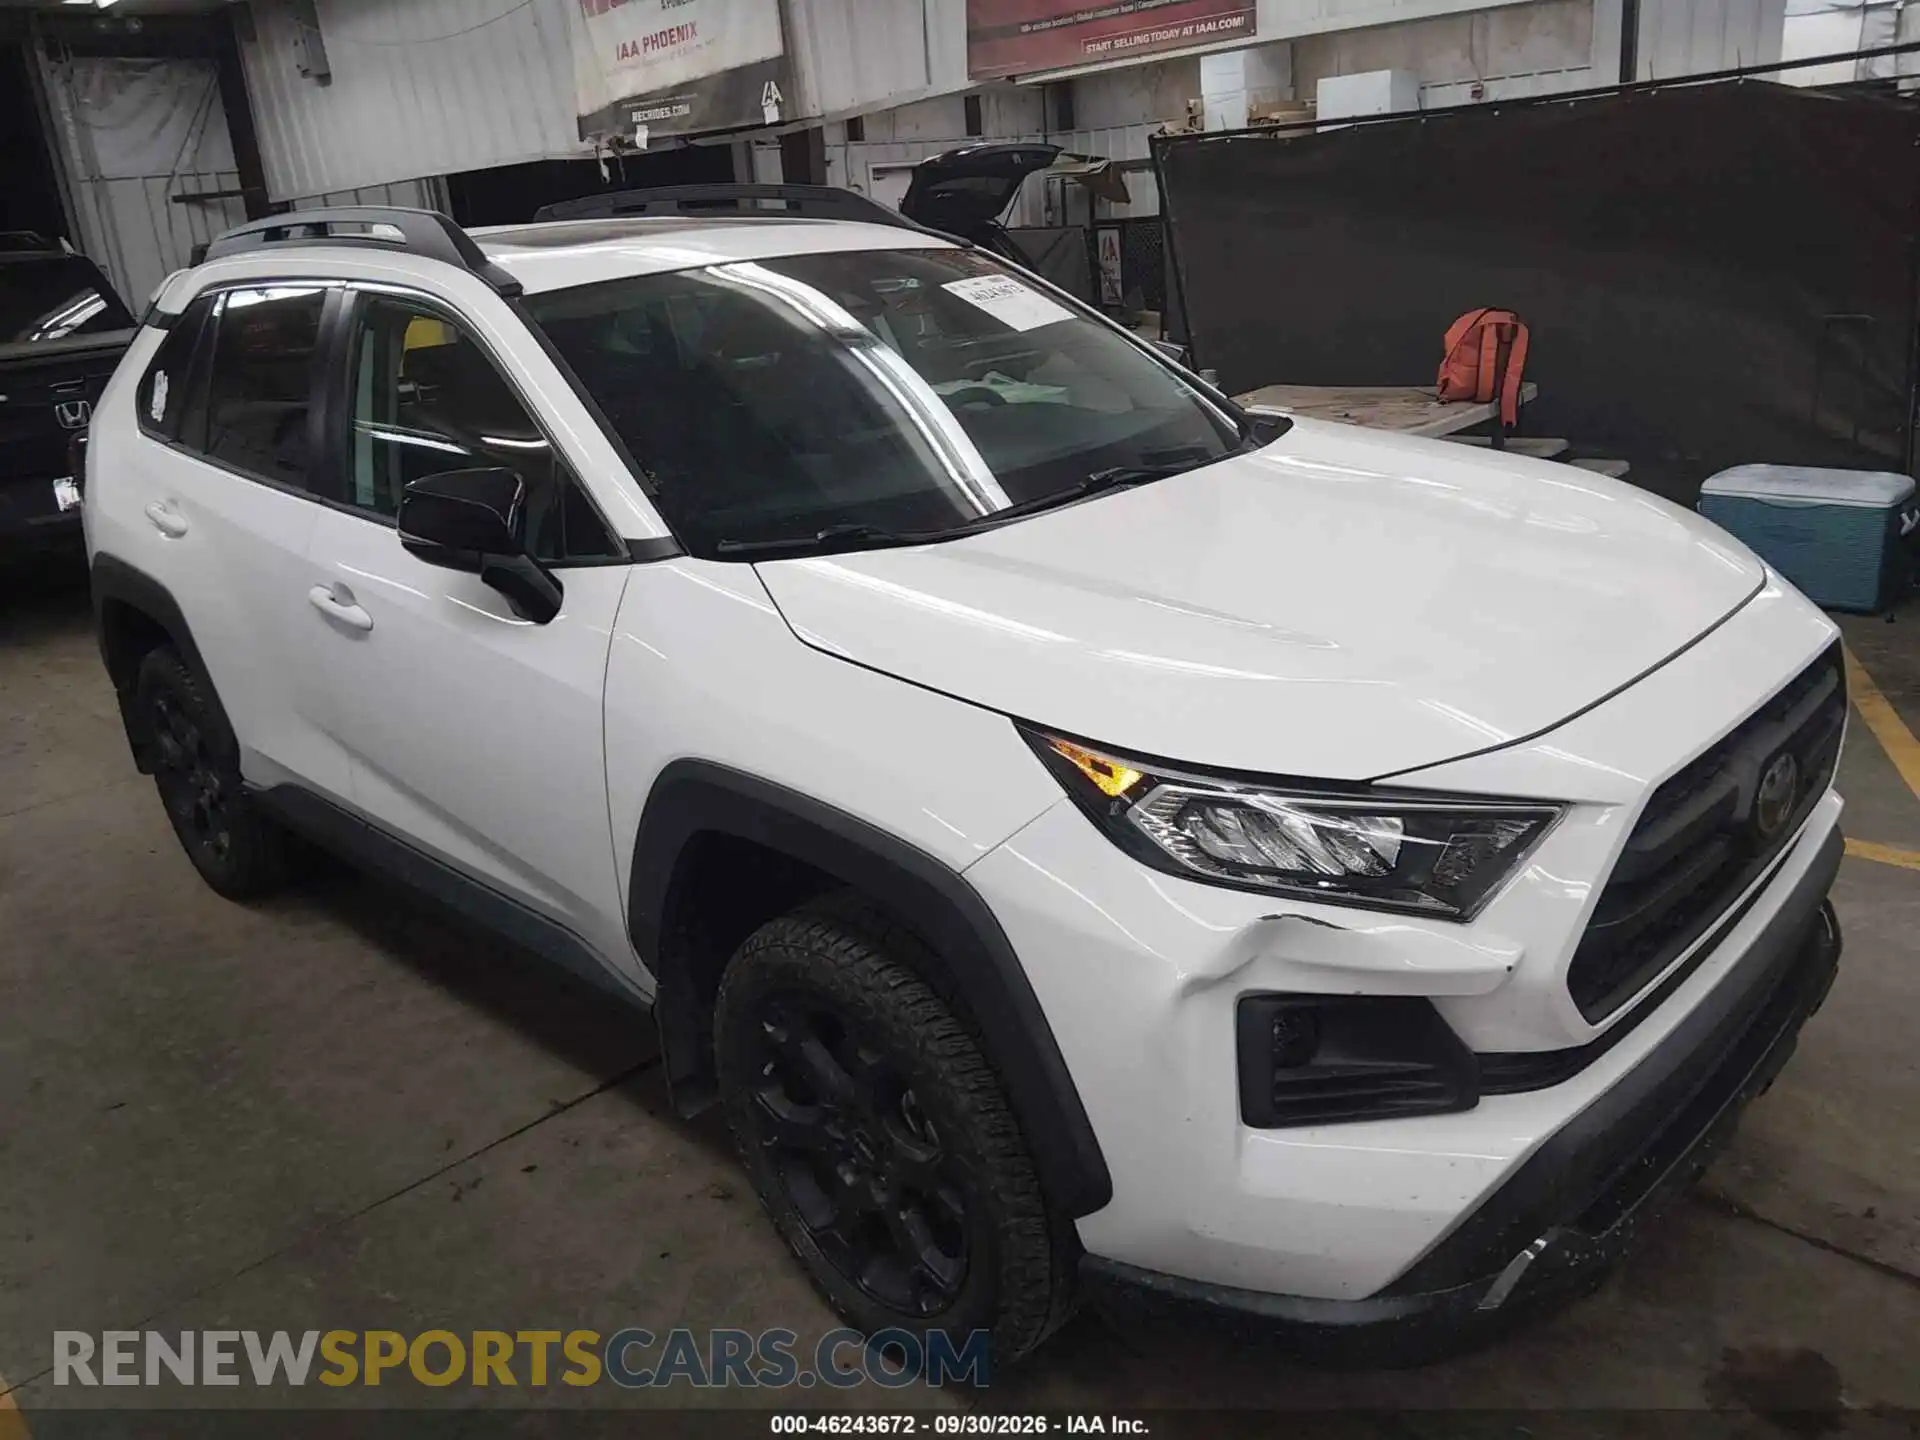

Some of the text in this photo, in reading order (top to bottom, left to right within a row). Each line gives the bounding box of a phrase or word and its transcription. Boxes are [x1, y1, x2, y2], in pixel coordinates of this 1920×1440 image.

[616, 40, 640, 61] IAA
[642, 21, 698, 53] PHOENIX
[1086, 40, 1113, 54] START
[1114, 33, 1150, 50] SELLING
[1150, 28, 1181, 43] TODAY
[1182, 25, 1195, 37] AT
